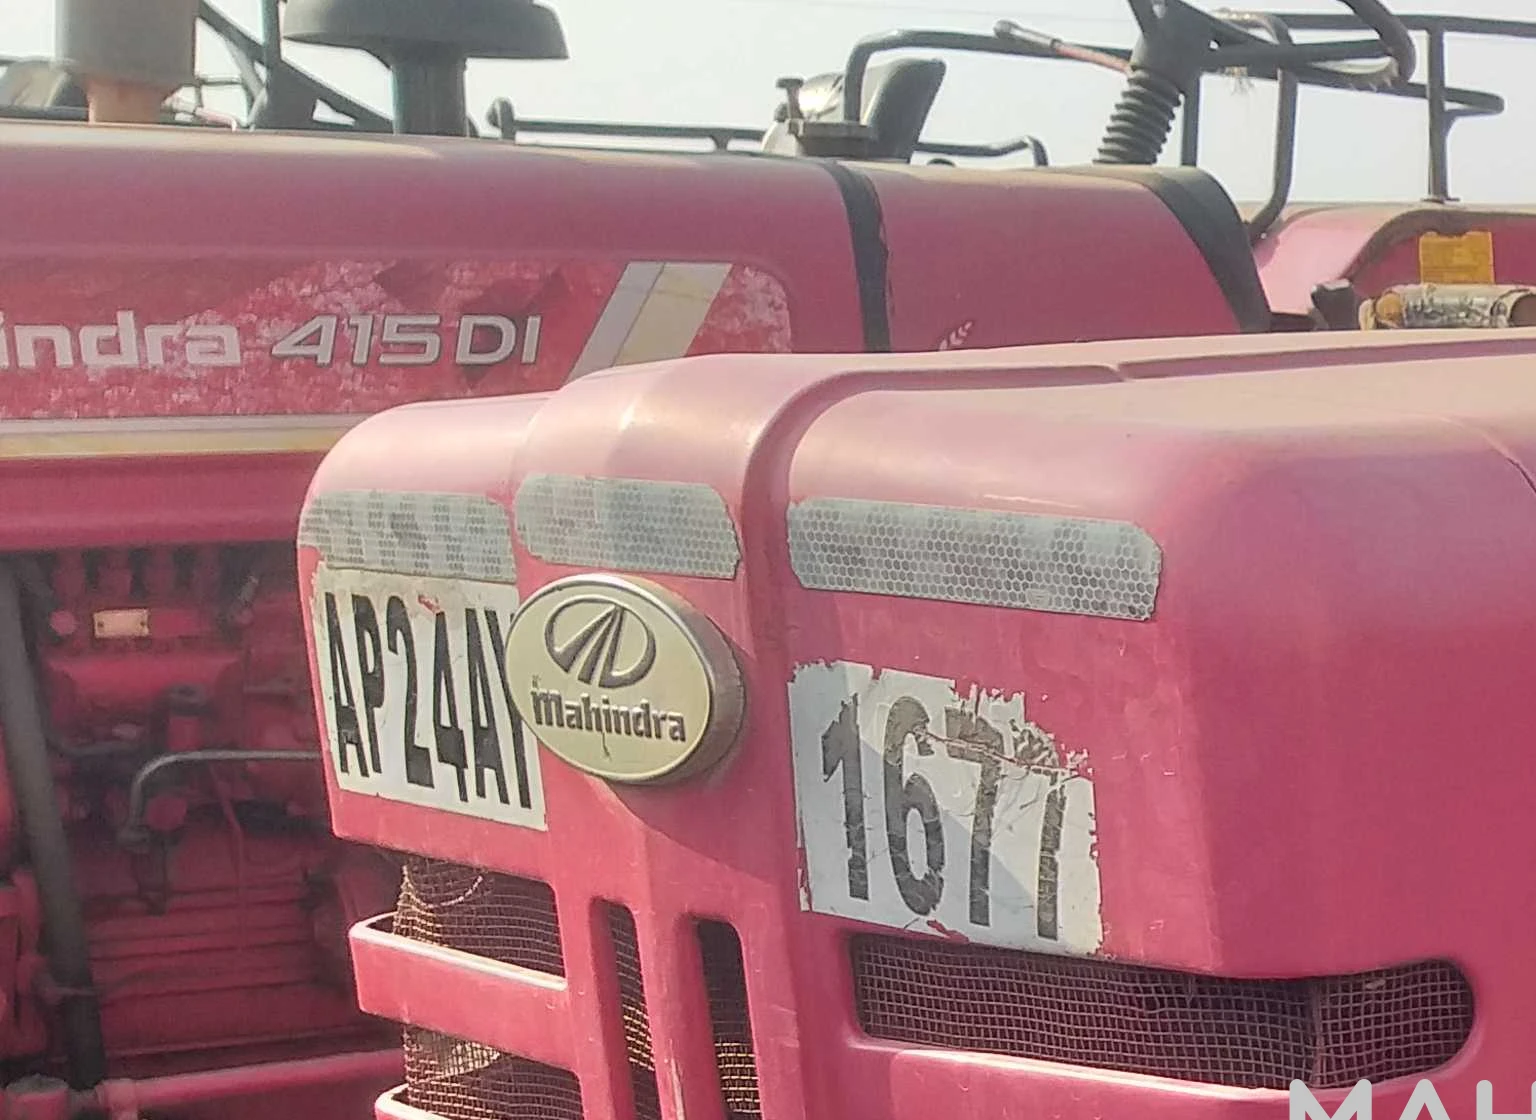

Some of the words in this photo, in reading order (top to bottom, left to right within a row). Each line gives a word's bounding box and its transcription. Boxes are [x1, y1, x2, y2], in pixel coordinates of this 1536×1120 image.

[272, 314, 441, 367] 415
[455, 314, 541, 365] DI
[531, 686, 687, 743] Mahindra
[821, 692, 1067, 941] 1677
